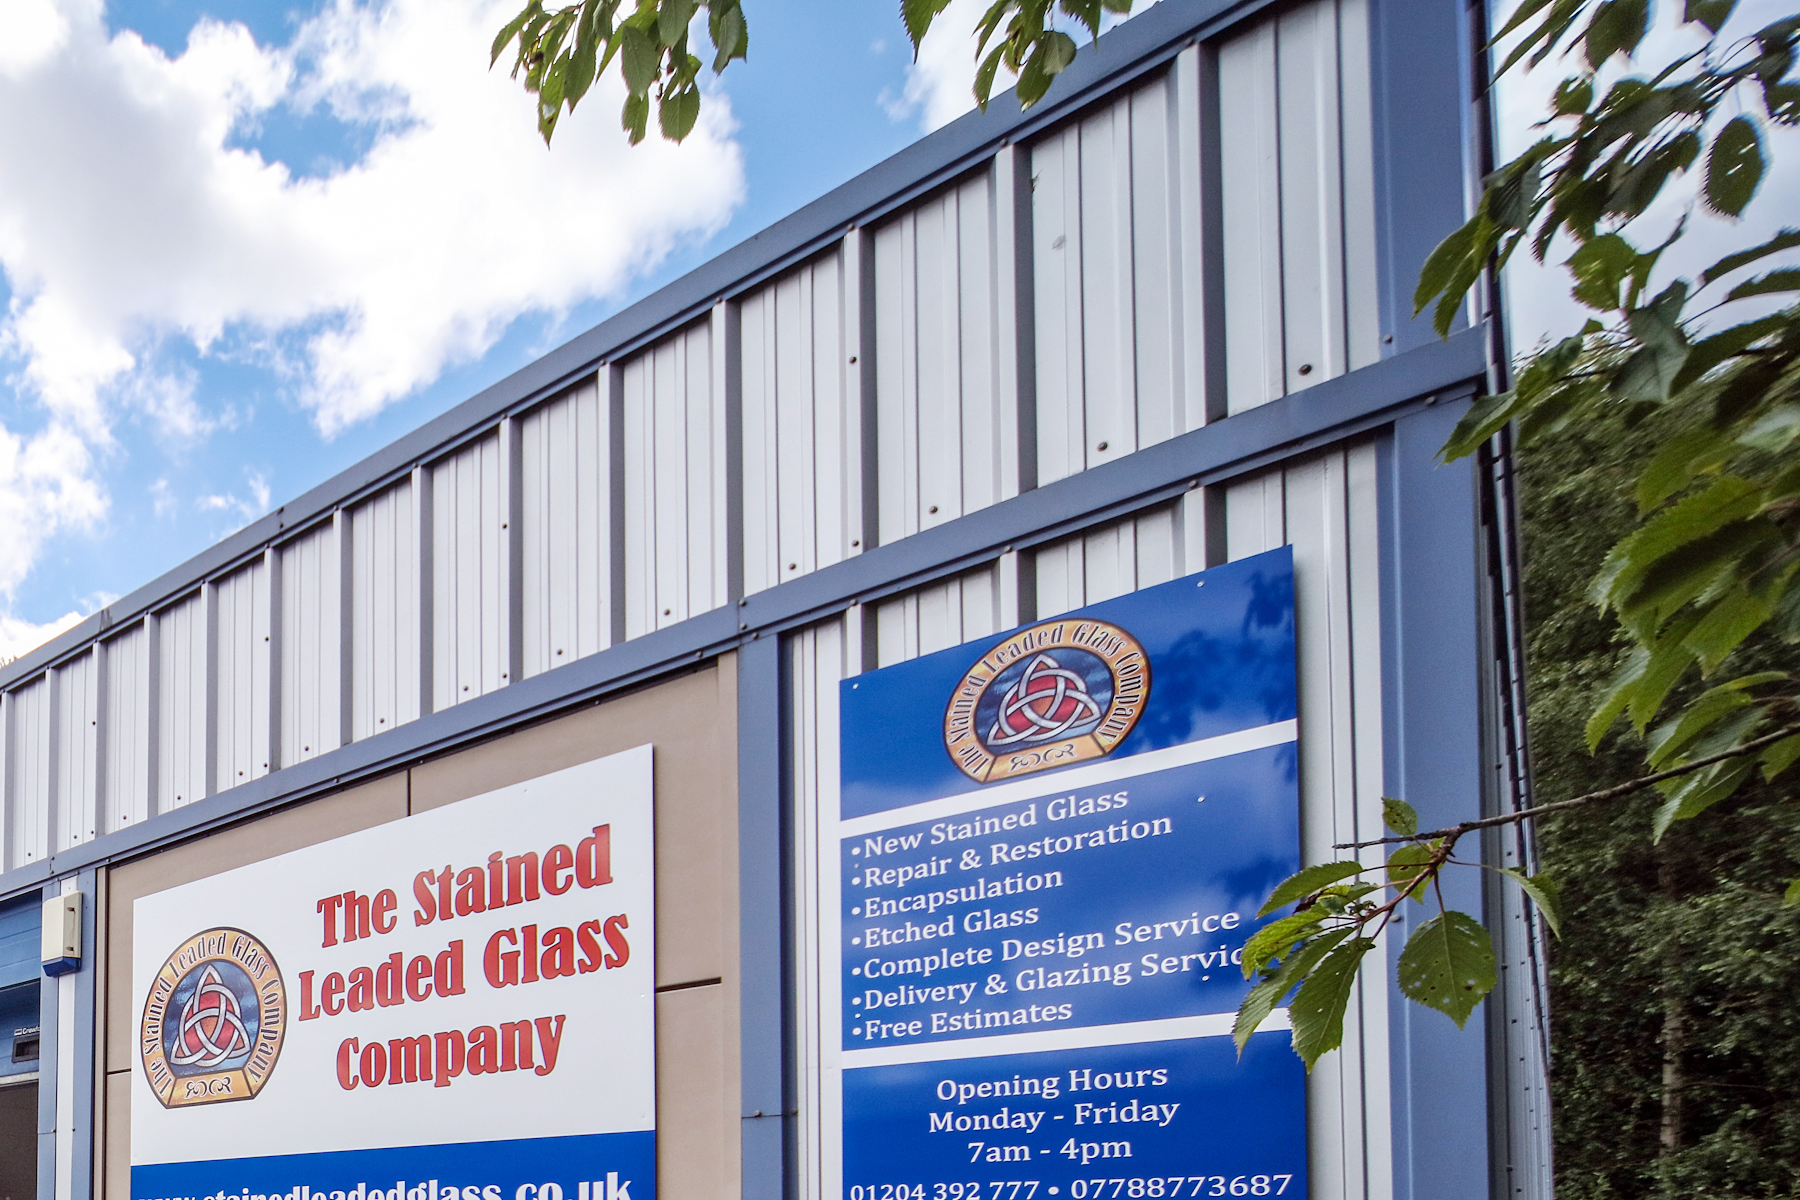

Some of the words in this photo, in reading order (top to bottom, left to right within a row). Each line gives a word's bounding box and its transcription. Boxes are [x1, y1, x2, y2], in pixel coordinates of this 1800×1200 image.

[981, 624, 1065, 675] Leaded
[1071, 621, 1126, 657] Glass
[948, 674, 987, 746] Stained
[1096, 651, 1144, 744] Company
[957, 742, 990, 777] The
[865, 834, 923, 858] New
[931, 804, 1037, 845] Stained
[1047, 790, 1128, 822] Glass
[865, 855, 952, 889] Repair
[959, 848, 982, 870] &
[991, 817, 1172, 866] Restoration
[317, 888, 398, 948] The
[413, 823, 613, 927] Stained
[865, 870, 1063, 918] Encapsulation
[864, 947, 993, 980] Complete
[1002, 933, 1104, 961] Design
[1115, 911, 1240, 945] Service
[865, 912, 955, 949] Etched
[963, 906, 1039, 932] Glass
[169, 932, 227, 978] Leaded
[231, 934, 271, 980] Glass
[298, 939, 466, 1022] Leaded
[483, 913, 630, 989] Glass
[865, 977, 977, 1011] Delivery
[985, 974, 1008, 997] &
[1015, 961, 1132, 992] Glazing
[1141, 947, 1243, 977] Servic
[144, 976, 173, 1056] Stained
[248, 978, 281, 1083] Company
[865, 1016, 922, 1040] Free
[931, 1004, 1072, 1034] Estimates
[150, 1057, 173, 1097] The
[336, 1014, 566, 1091] Company
[936, 1075, 1060, 1105] Opening
[1069, 1068, 1168, 1092] Hours
[928, 1108, 1045, 1134] Monday
[1074, 1099, 1181, 1127] Friday
[967, 1142, 1031, 1163] 7am
[1059, 1138, 1132, 1165] 4pm
[989, 1180, 1040, 1200] 777
[1070, 1173, 1293, 1200] 07788773687
